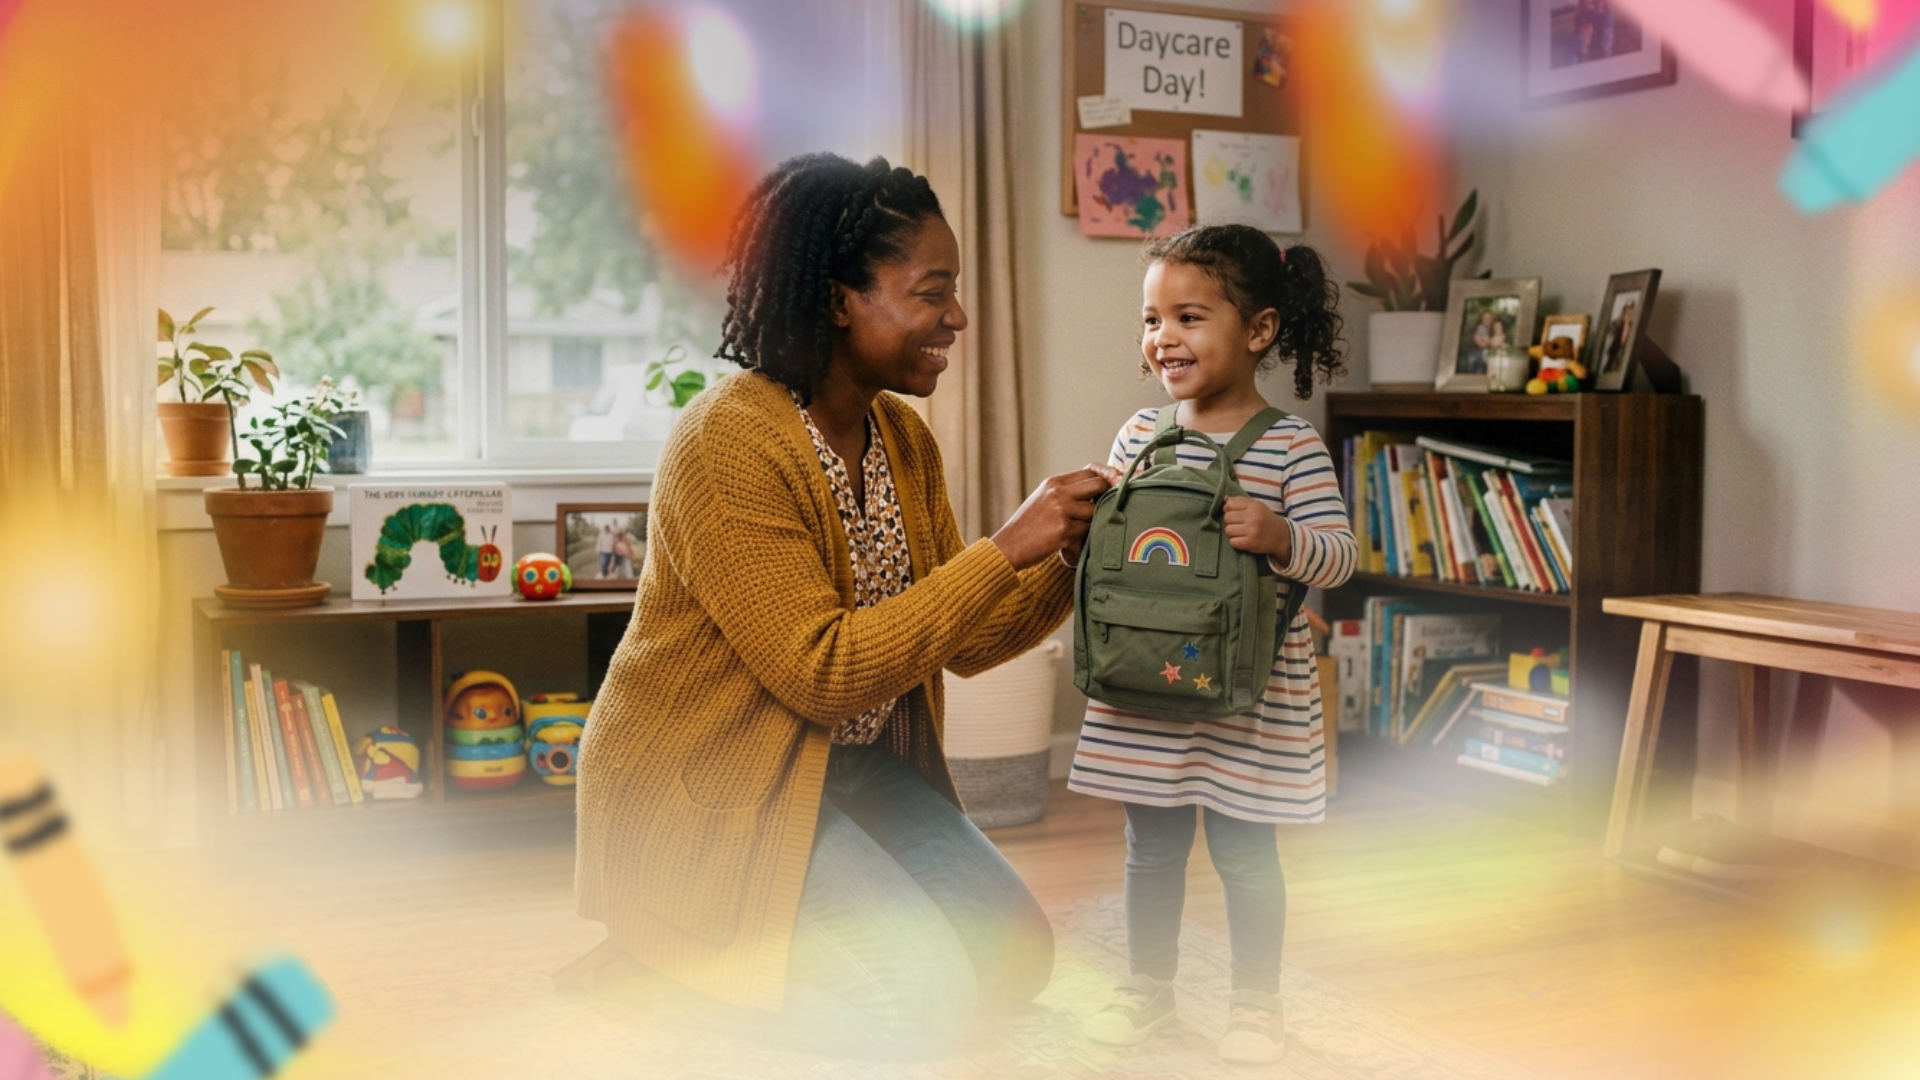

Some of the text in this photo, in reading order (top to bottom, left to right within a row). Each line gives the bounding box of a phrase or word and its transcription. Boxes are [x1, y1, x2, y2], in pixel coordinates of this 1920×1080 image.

[1118, 21, 1231, 59] Daycare
[1143, 65, 1205, 103] Day!
[364, 490, 381, 499] THE
